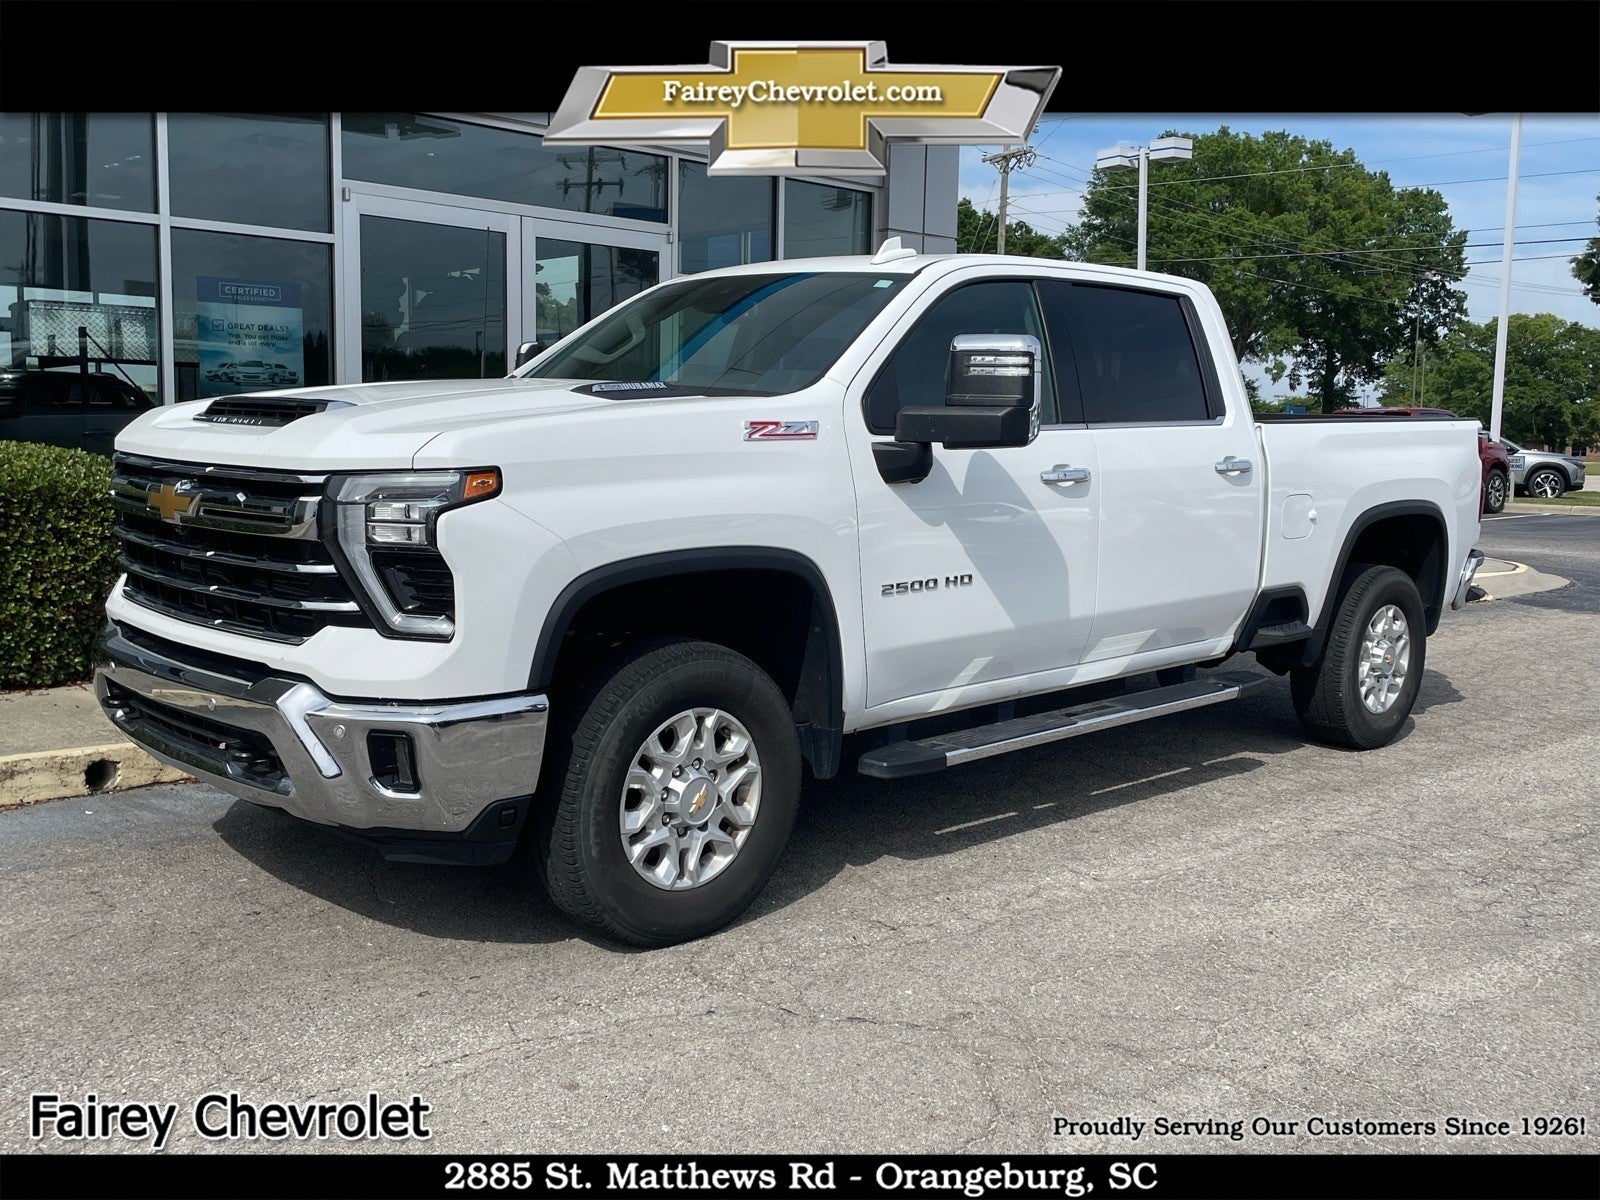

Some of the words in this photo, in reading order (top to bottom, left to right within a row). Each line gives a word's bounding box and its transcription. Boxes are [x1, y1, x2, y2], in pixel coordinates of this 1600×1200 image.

[225, 286, 276, 297] CERTIFIED
[227, 323, 256, 331] GREAT
[258, 324, 289, 332] DEALS?
[227, 332, 242, 340] Yep.
[258, 334, 269, 342] get
[622, 381, 667, 390] DURAMAX
[743, 421, 819, 441] Z71
[881, 578, 938, 597] 2500
[945, 574, 973, 589] HD
